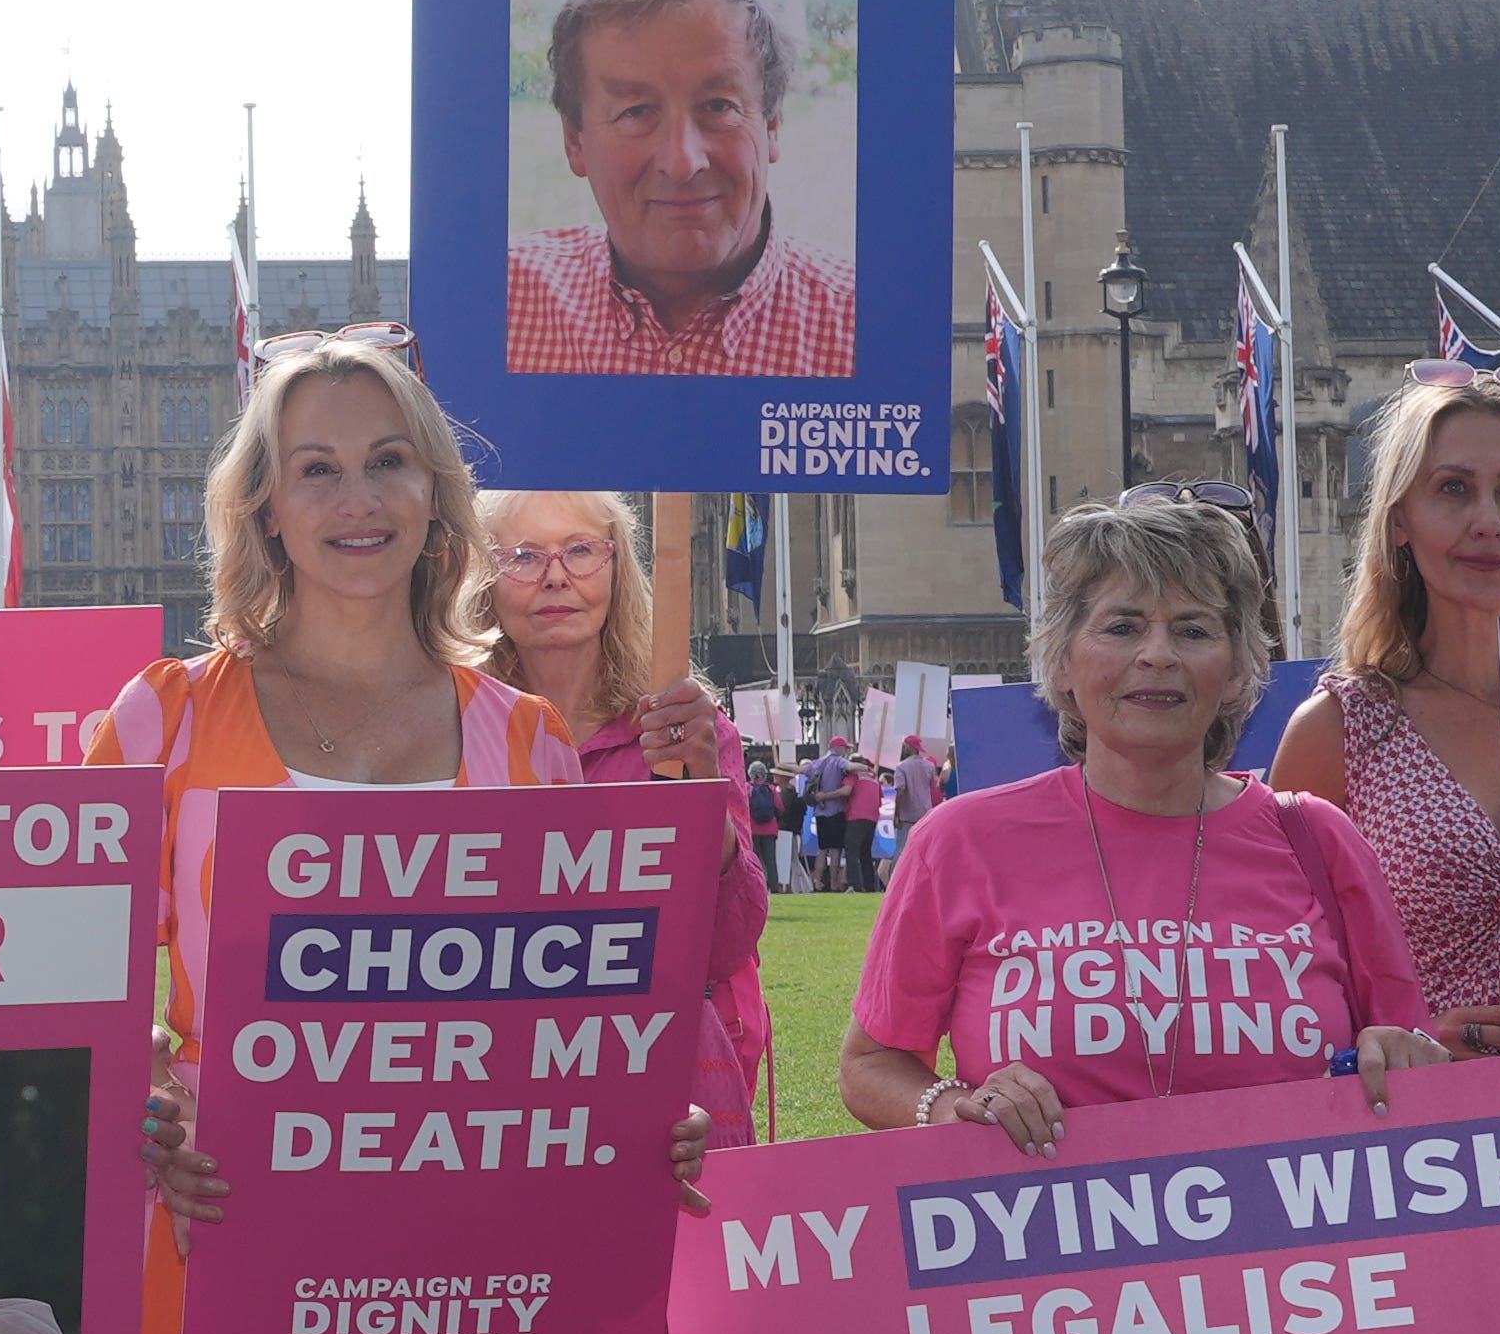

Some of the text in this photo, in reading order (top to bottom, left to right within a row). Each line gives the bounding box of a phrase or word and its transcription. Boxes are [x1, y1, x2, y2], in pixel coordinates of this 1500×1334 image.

[761, 420, 920, 447] DIGNITY
[762, 403, 920, 419] CAMPAIGN FOR
[761, 448, 930, 476] IN DYING.
[268, 827, 676, 898] GIVE ME
[280, 923, 643, 991] CHOICE
[988, 919, 1312, 957] CAMPAIGN FOR
[990, 948, 1314, 1006] DIGNITY
[233, 1012, 675, 1082] OVER MY
[989, 1002, 1335, 1063] IN DYING.
[272, 1107, 615, 1171] DEATH.
[722, 1206, 869, 1291] MY
[910, 1167, 1231, 1270] DYING
[296, 1274, 551, 1298] CAMPAIGN FOR
